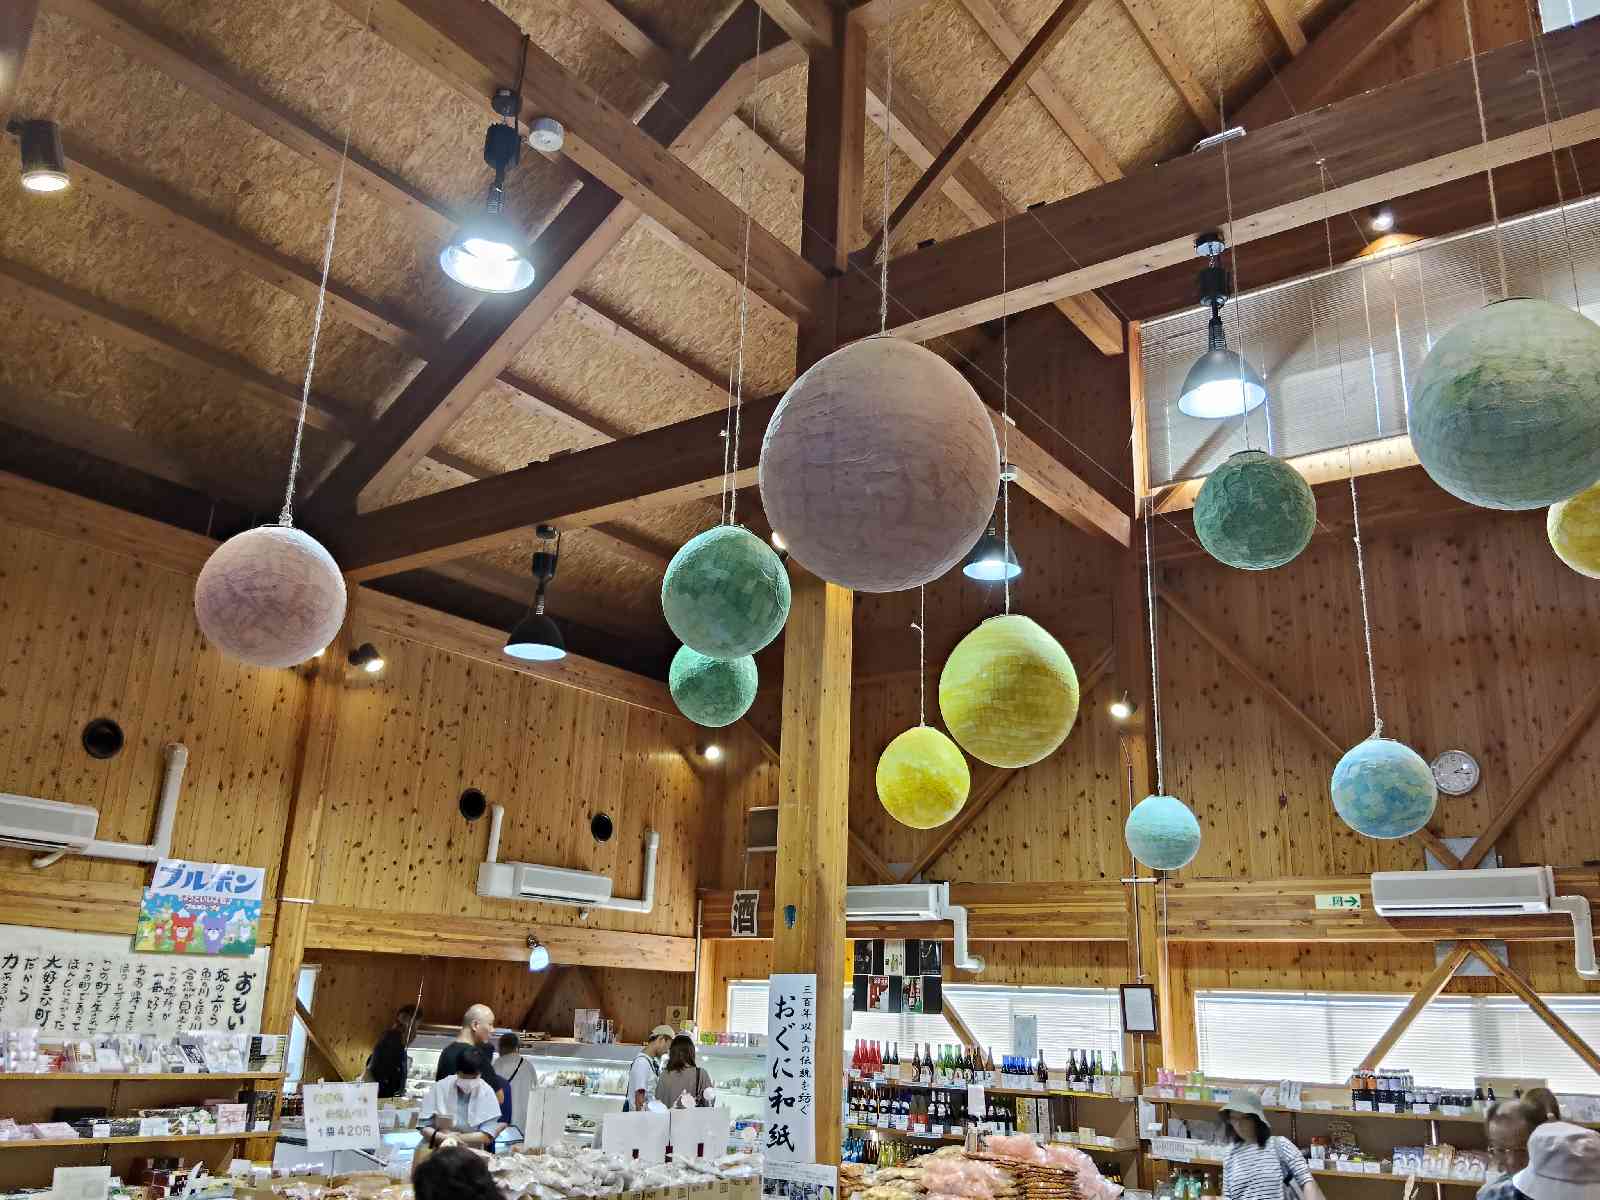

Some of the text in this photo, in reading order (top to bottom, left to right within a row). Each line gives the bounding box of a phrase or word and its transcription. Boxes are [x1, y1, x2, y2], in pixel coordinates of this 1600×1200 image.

[159, 863, 258, 894] ブルボン
[733, 893, 758, 934] 酒
[18, 956, 39, 1003] だから
[35, 955, 63, 1027] 大好きな町
[208, 967, 231, 1026] 坂の上から
[228, 971, 257, 1031] おもい
[766, 995, 796, 1153] おぐに和紙
